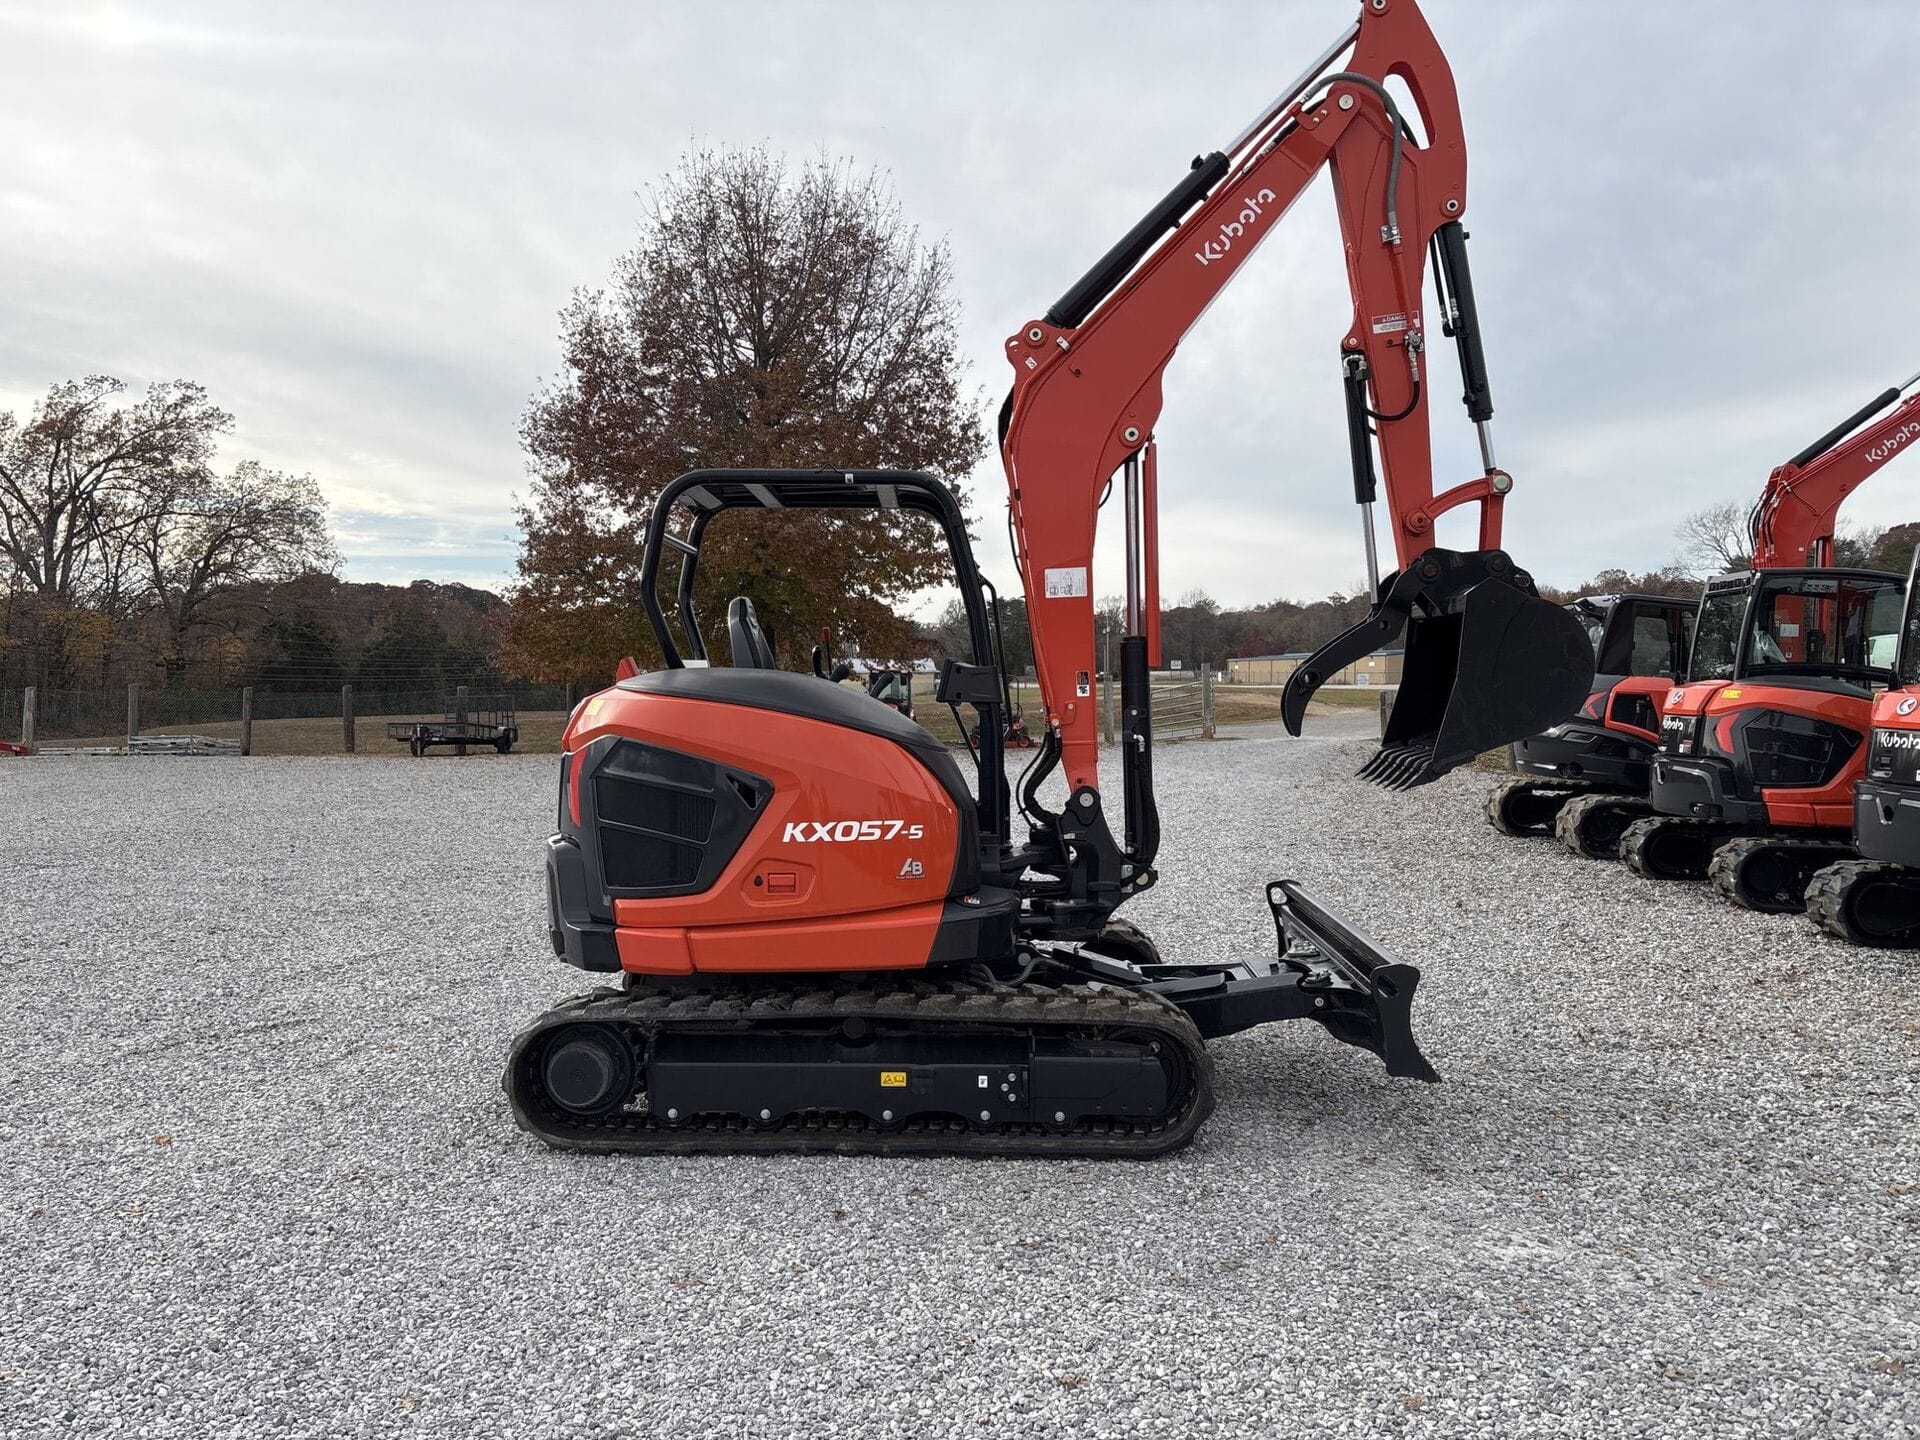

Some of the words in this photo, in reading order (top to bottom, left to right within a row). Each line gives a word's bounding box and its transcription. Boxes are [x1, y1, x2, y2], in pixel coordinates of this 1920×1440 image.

[1195, 188, 1276, 266] Kubota
[1386, 314, 1406, 322] DANG
[1865, 422, 1920, 463] Kubota
[1880, 731, 1920, 749] Kubota
[782, 819, 924, 843] KX057-5
